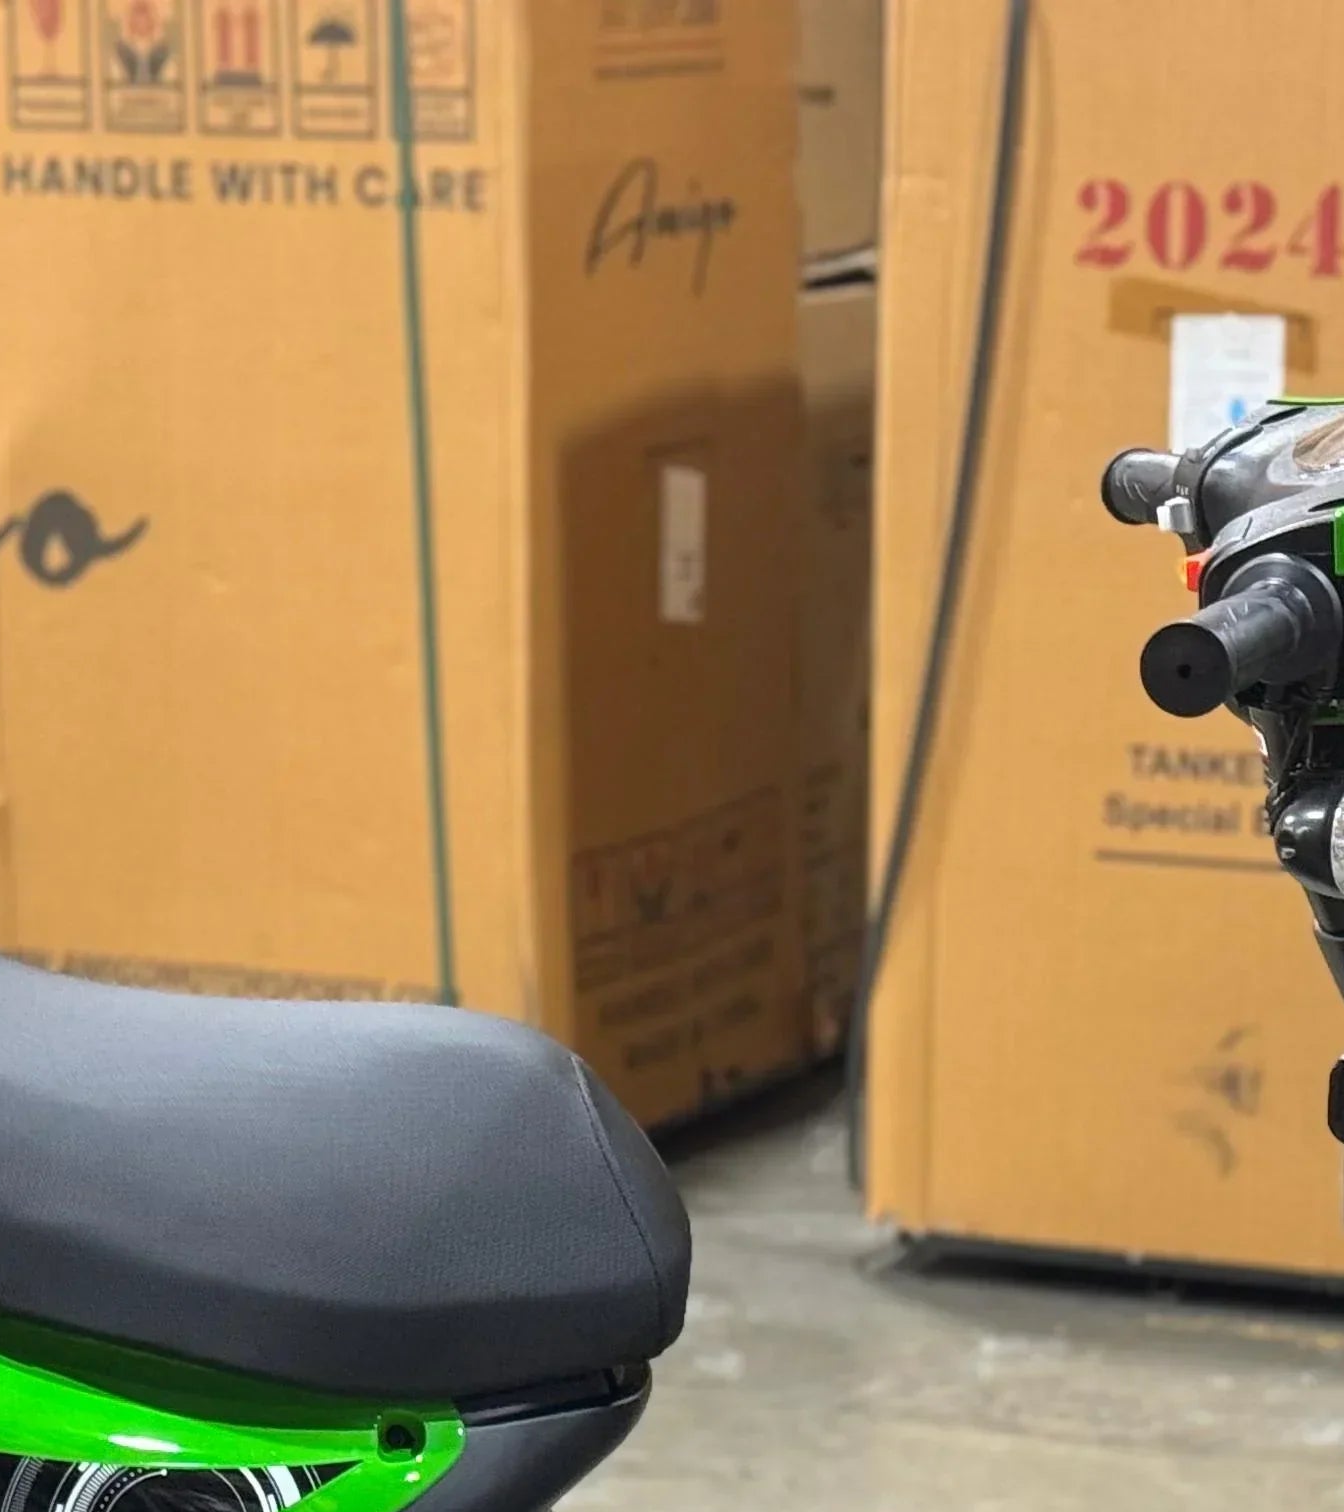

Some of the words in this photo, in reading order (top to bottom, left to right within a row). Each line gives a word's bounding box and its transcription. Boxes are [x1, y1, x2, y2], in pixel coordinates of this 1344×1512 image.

[2, 154, 193, 203] HANDLE
[211, 159, 338, 208] WITH
[584, 155, 736, 297] Amigo
